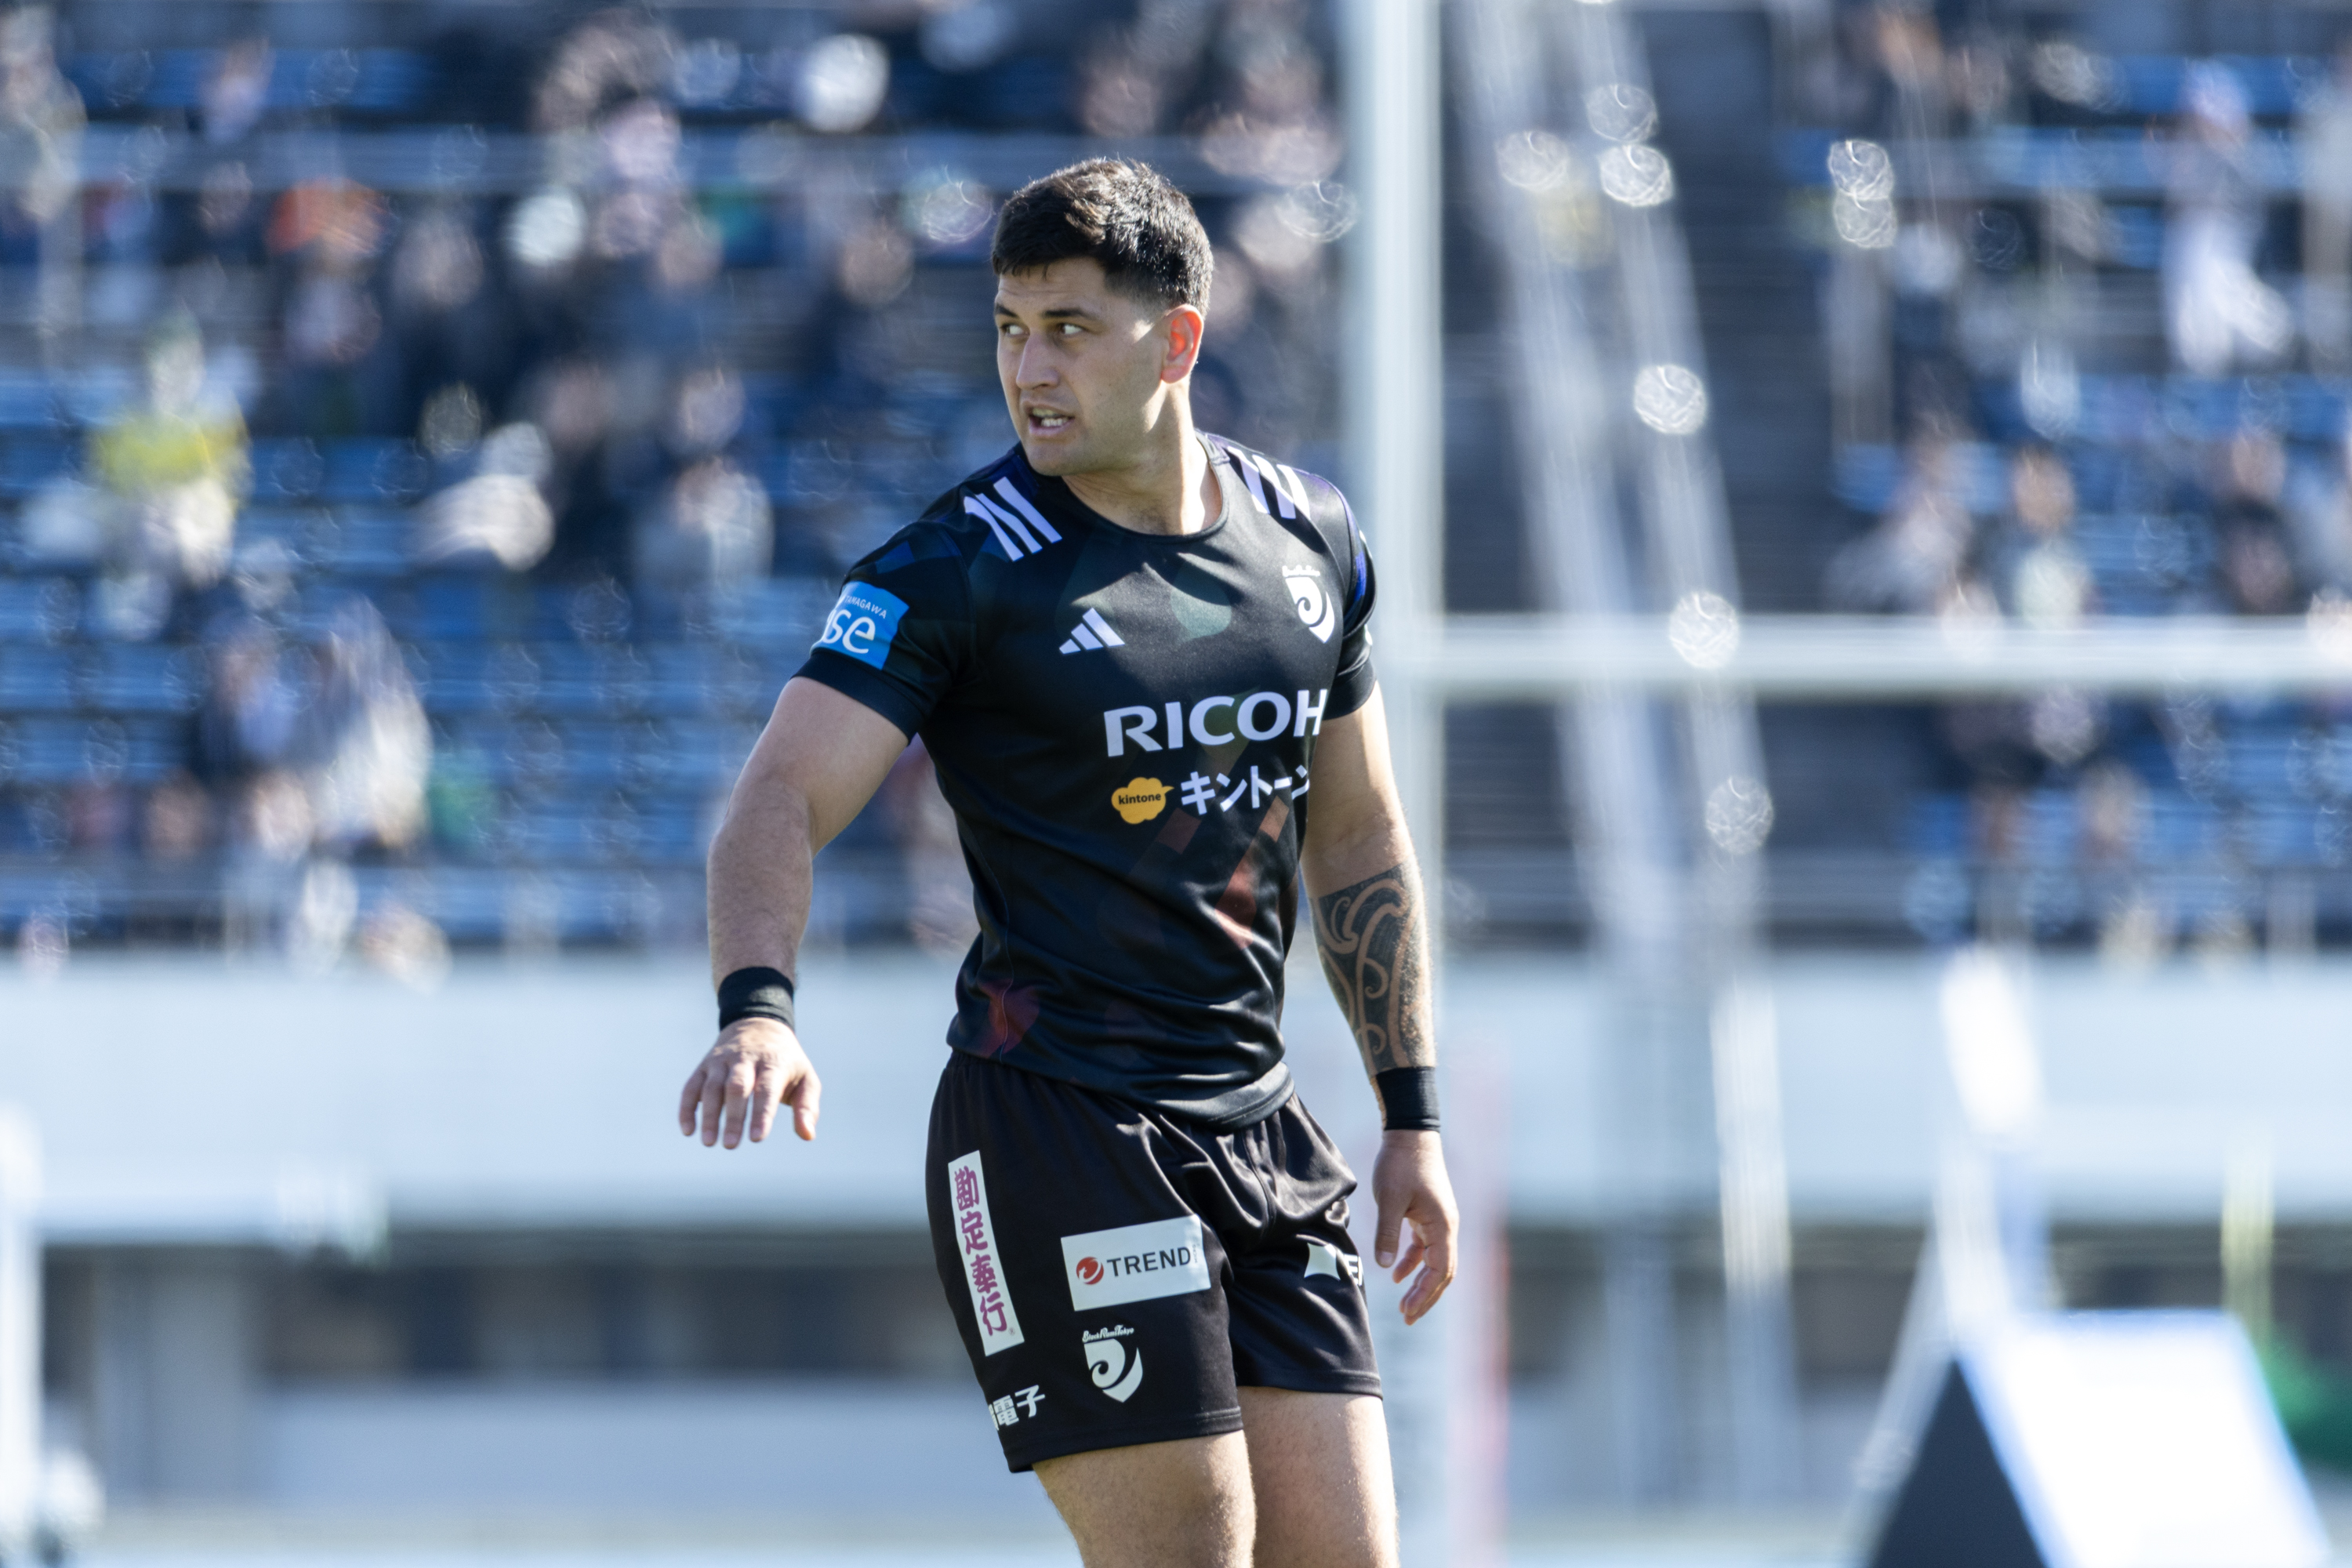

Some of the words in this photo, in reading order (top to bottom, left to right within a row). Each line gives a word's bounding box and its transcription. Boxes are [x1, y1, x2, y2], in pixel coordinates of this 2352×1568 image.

[822, 609, 876, 654] se
[1104, 688, 1328, 757] RICOH
[1118, 793, 1162, 805] kintone
[1181, 765, 1310, 815] キントーン
[954, 1166, 1007, 1336] 勘定奉行
[1106, 1247, 1191, 1277] TREND
[988, 1385, 1045, 1431] 電子
